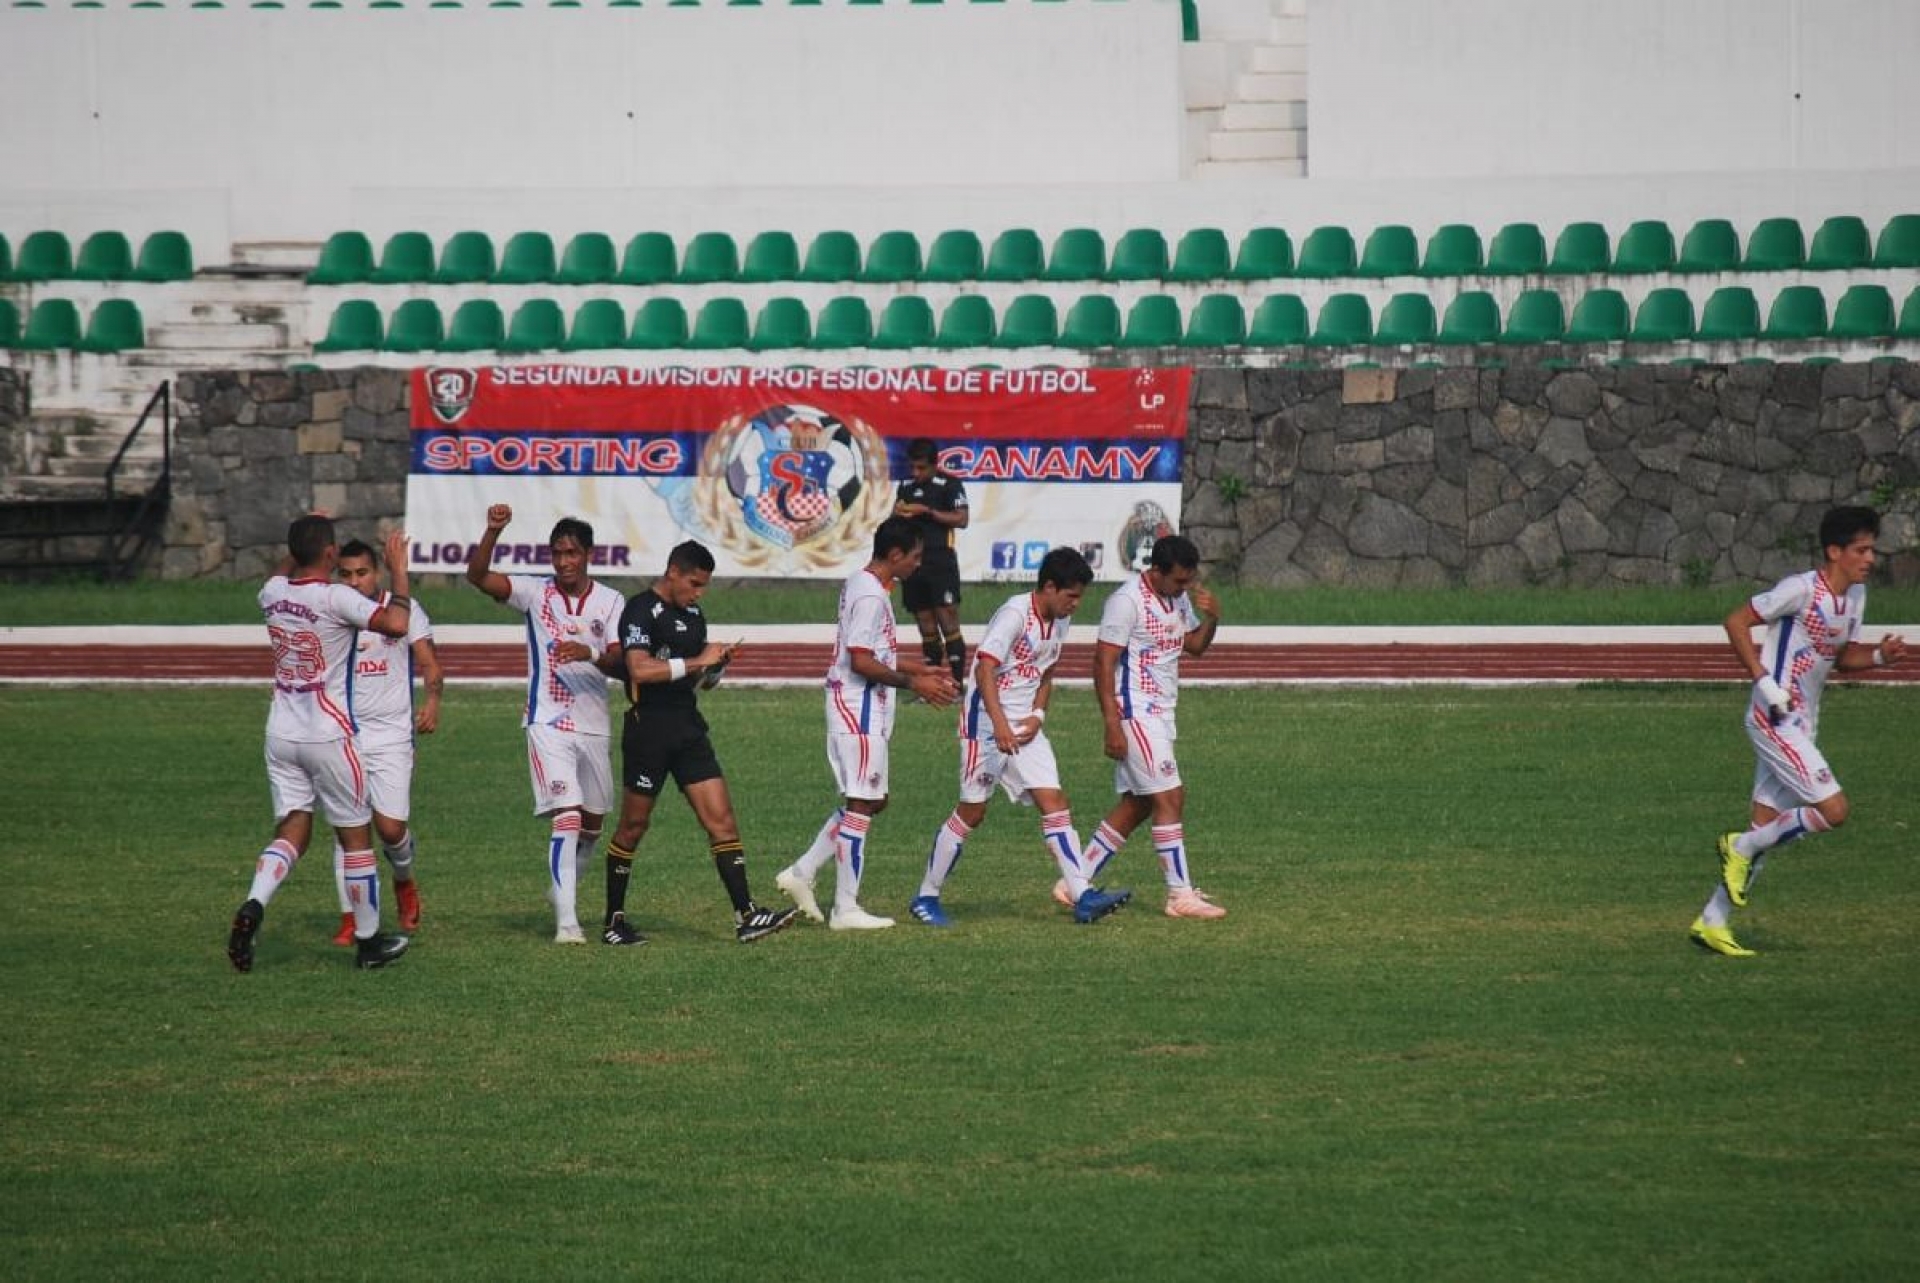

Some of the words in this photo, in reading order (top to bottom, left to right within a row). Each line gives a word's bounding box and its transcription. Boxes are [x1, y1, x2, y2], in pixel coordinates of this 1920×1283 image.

[492, 366, 622, 386] SEGUNDA
[628, 367, 741, 387] DIVISION
[750, 368, 936, 392] PROFESIONAL
[945, 370, 982, 393] DE
[990, 370, 1096, 393] FUTBOL
[424, 437, 682, 471] SPORTING
[937, 447, 1160, 479] CANAMY
[492, 545, 630, 566] PREER
